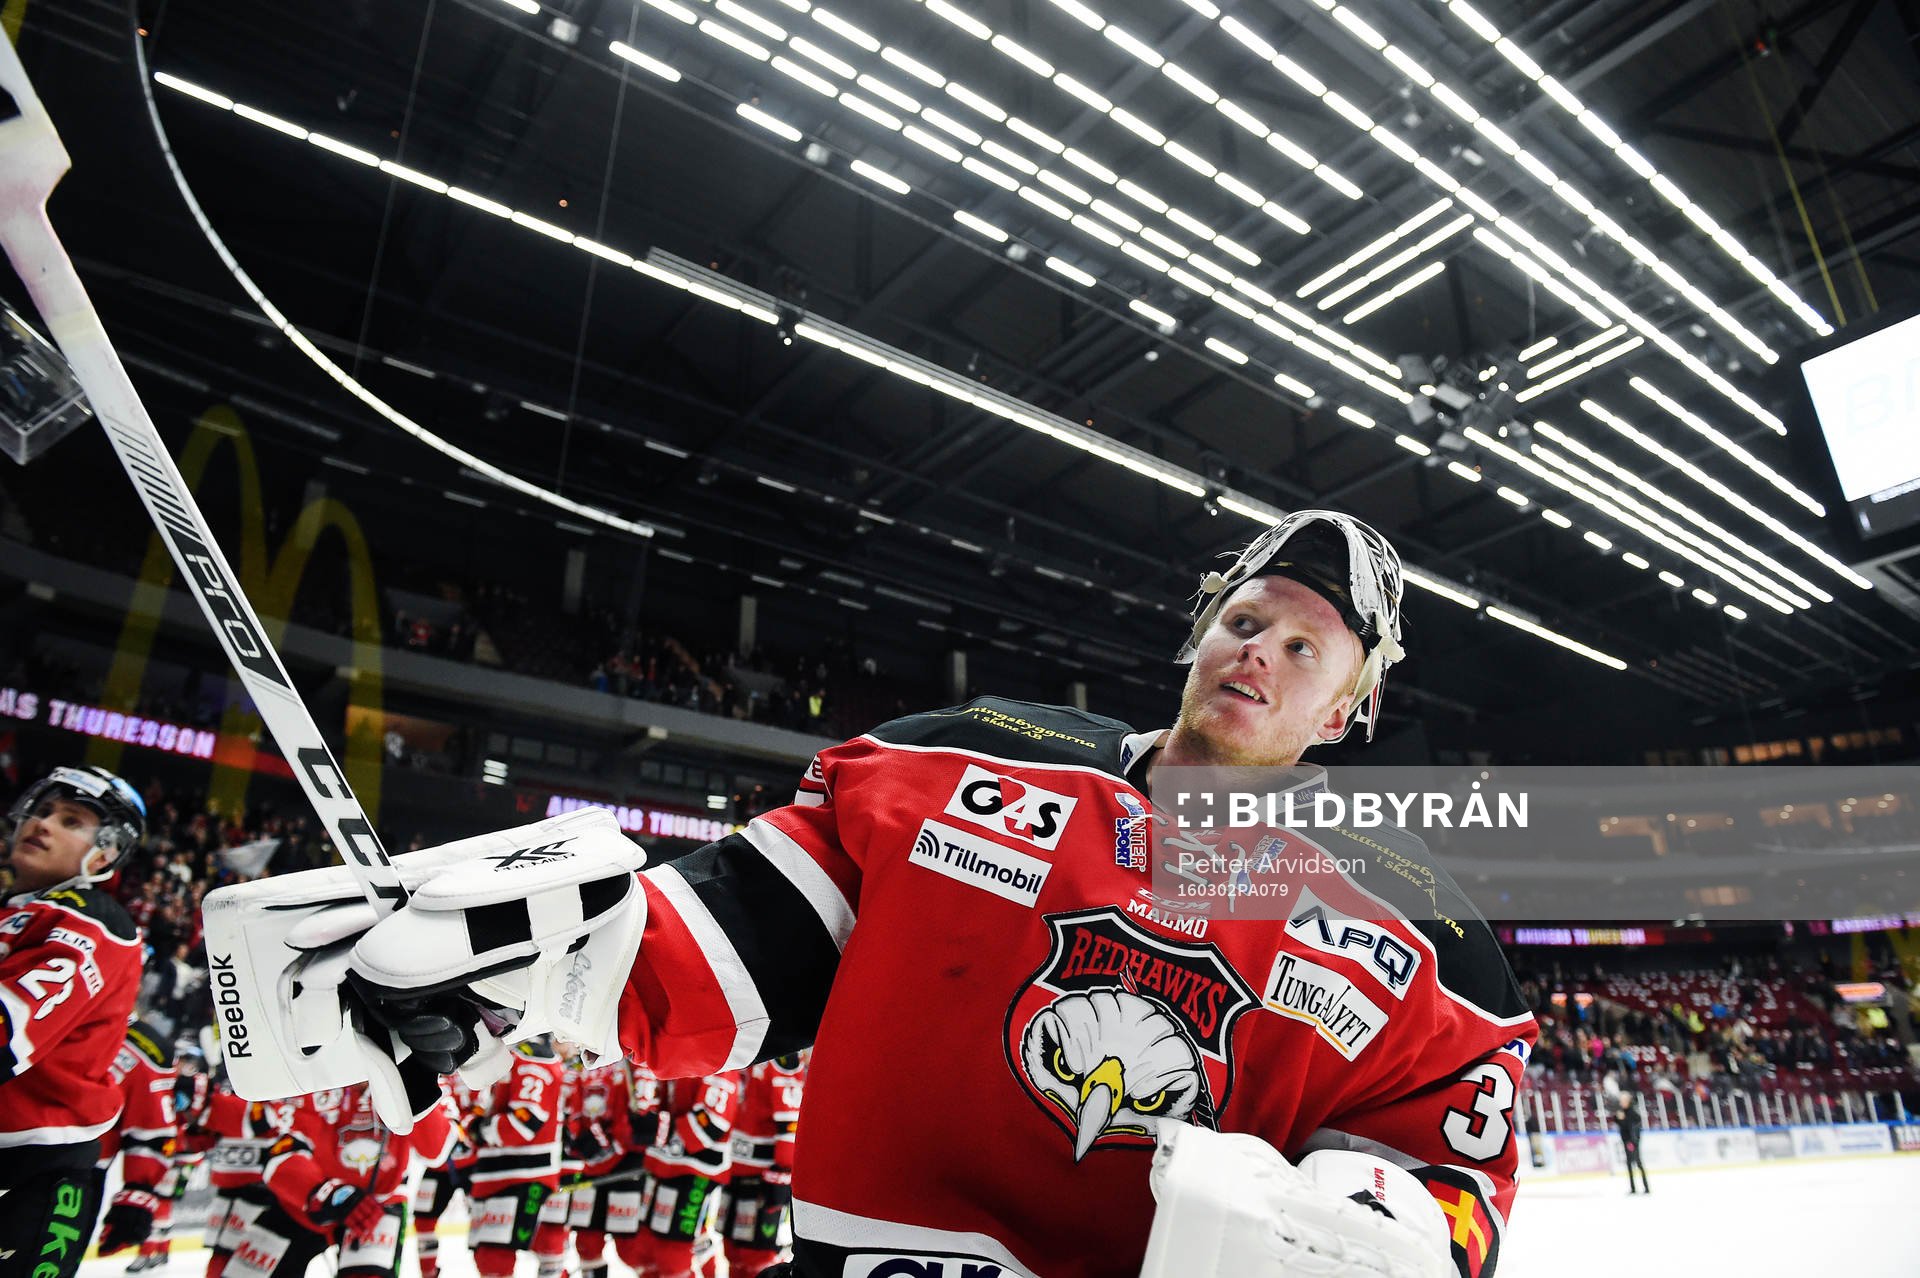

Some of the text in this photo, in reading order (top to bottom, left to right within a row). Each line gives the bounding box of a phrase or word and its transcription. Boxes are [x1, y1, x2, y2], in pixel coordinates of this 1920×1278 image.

[961, 777, 1062, 841] G4S
[944, 841, 1043, 894] Tillmobil
[1126, 898, 1209, 939] MALMÖ
[207, 953, 252, 1059] Reebok
[1060, 926, 1228, 1039] REDHAWKS
